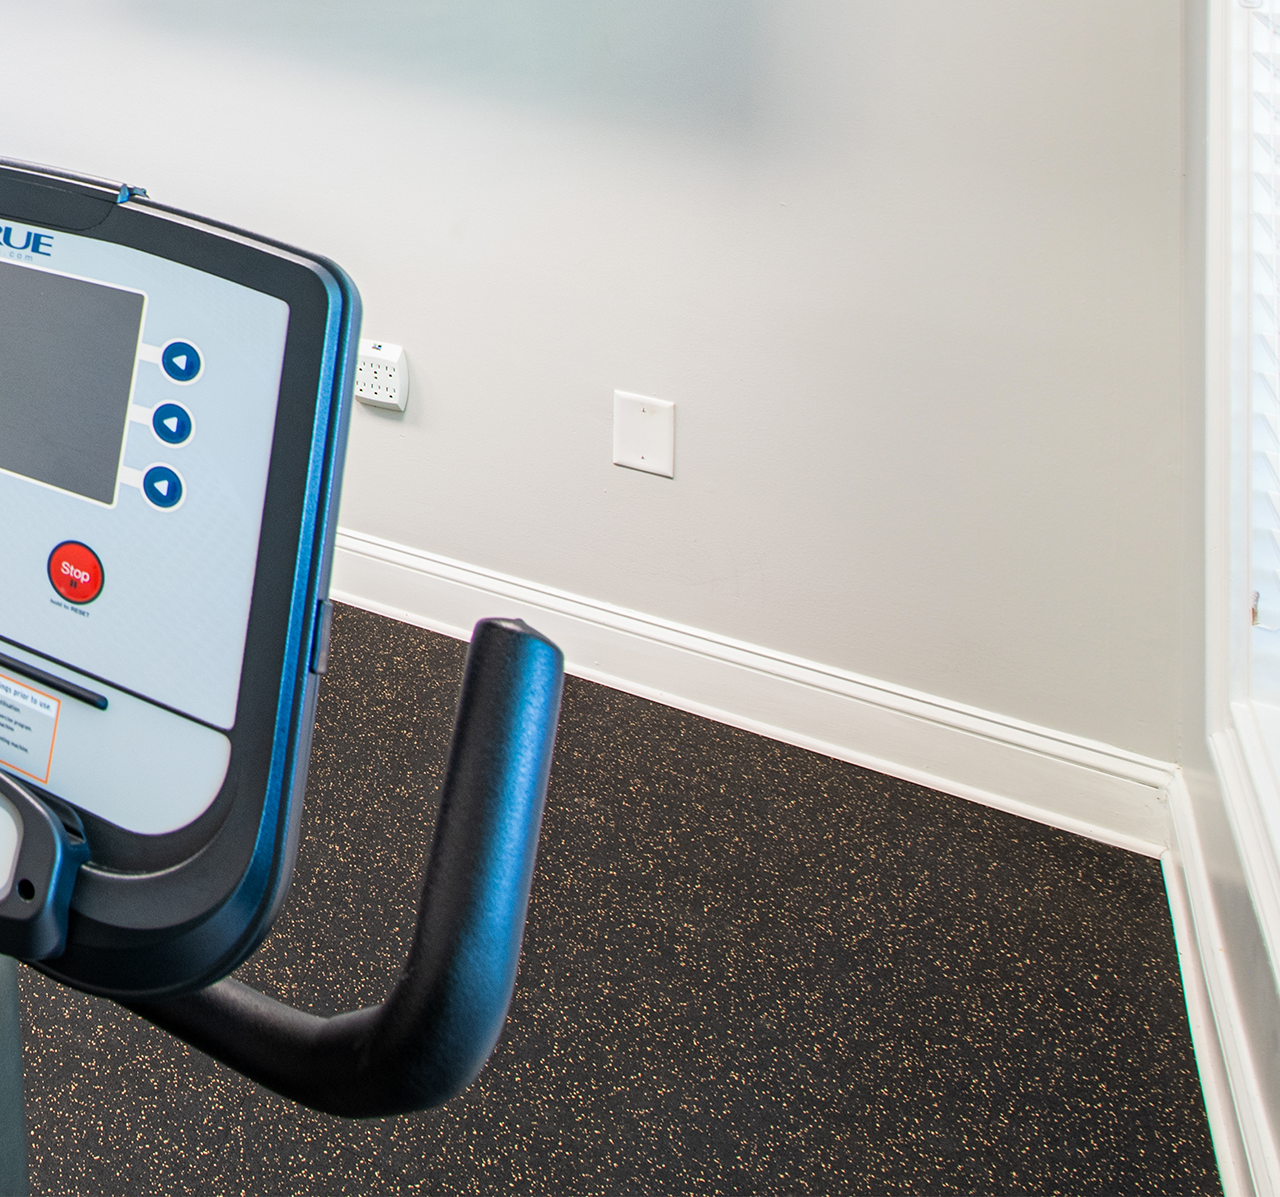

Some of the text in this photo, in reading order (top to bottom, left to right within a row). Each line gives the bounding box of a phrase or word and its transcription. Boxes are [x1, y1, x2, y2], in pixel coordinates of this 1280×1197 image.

[60, 561, 90, 584] Stop
[70, 606, 90, 618] RESET
[13, 689, 28, 700] prior
[30, 696, 37, 704] to
